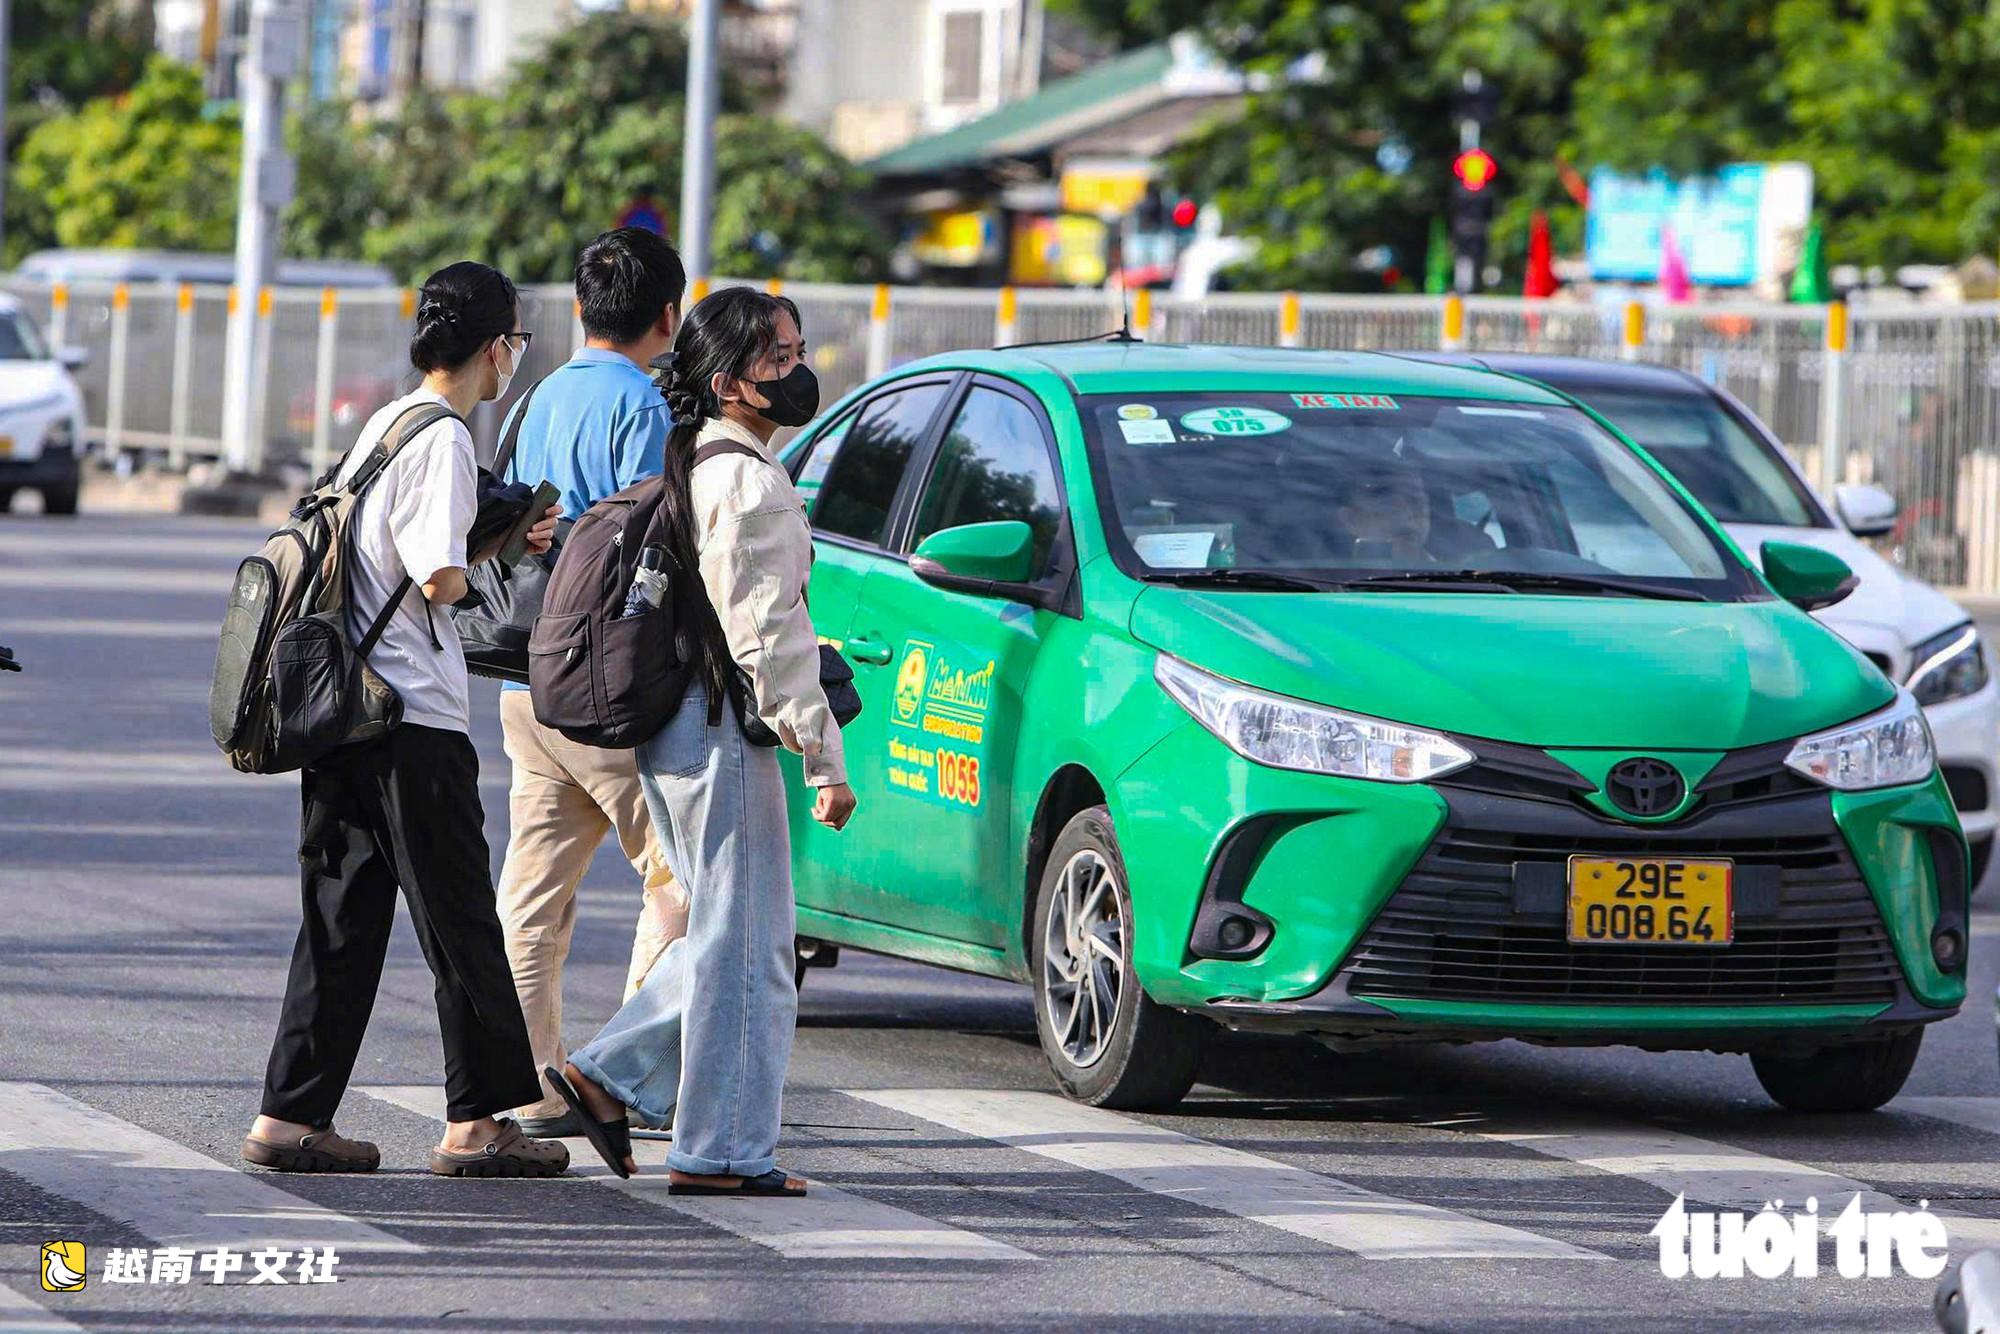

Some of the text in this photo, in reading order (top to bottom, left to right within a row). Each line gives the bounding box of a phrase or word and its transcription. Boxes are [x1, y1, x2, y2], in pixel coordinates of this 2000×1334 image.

[1296, 395, 1394, 408] XE TAXI
[1212, 418, 1266, 433] 075
[936, 747, 980, 807] 1055
[1615, 862, 1685, 900] 29E
[1586, 903, 1714, 940] 008.64
